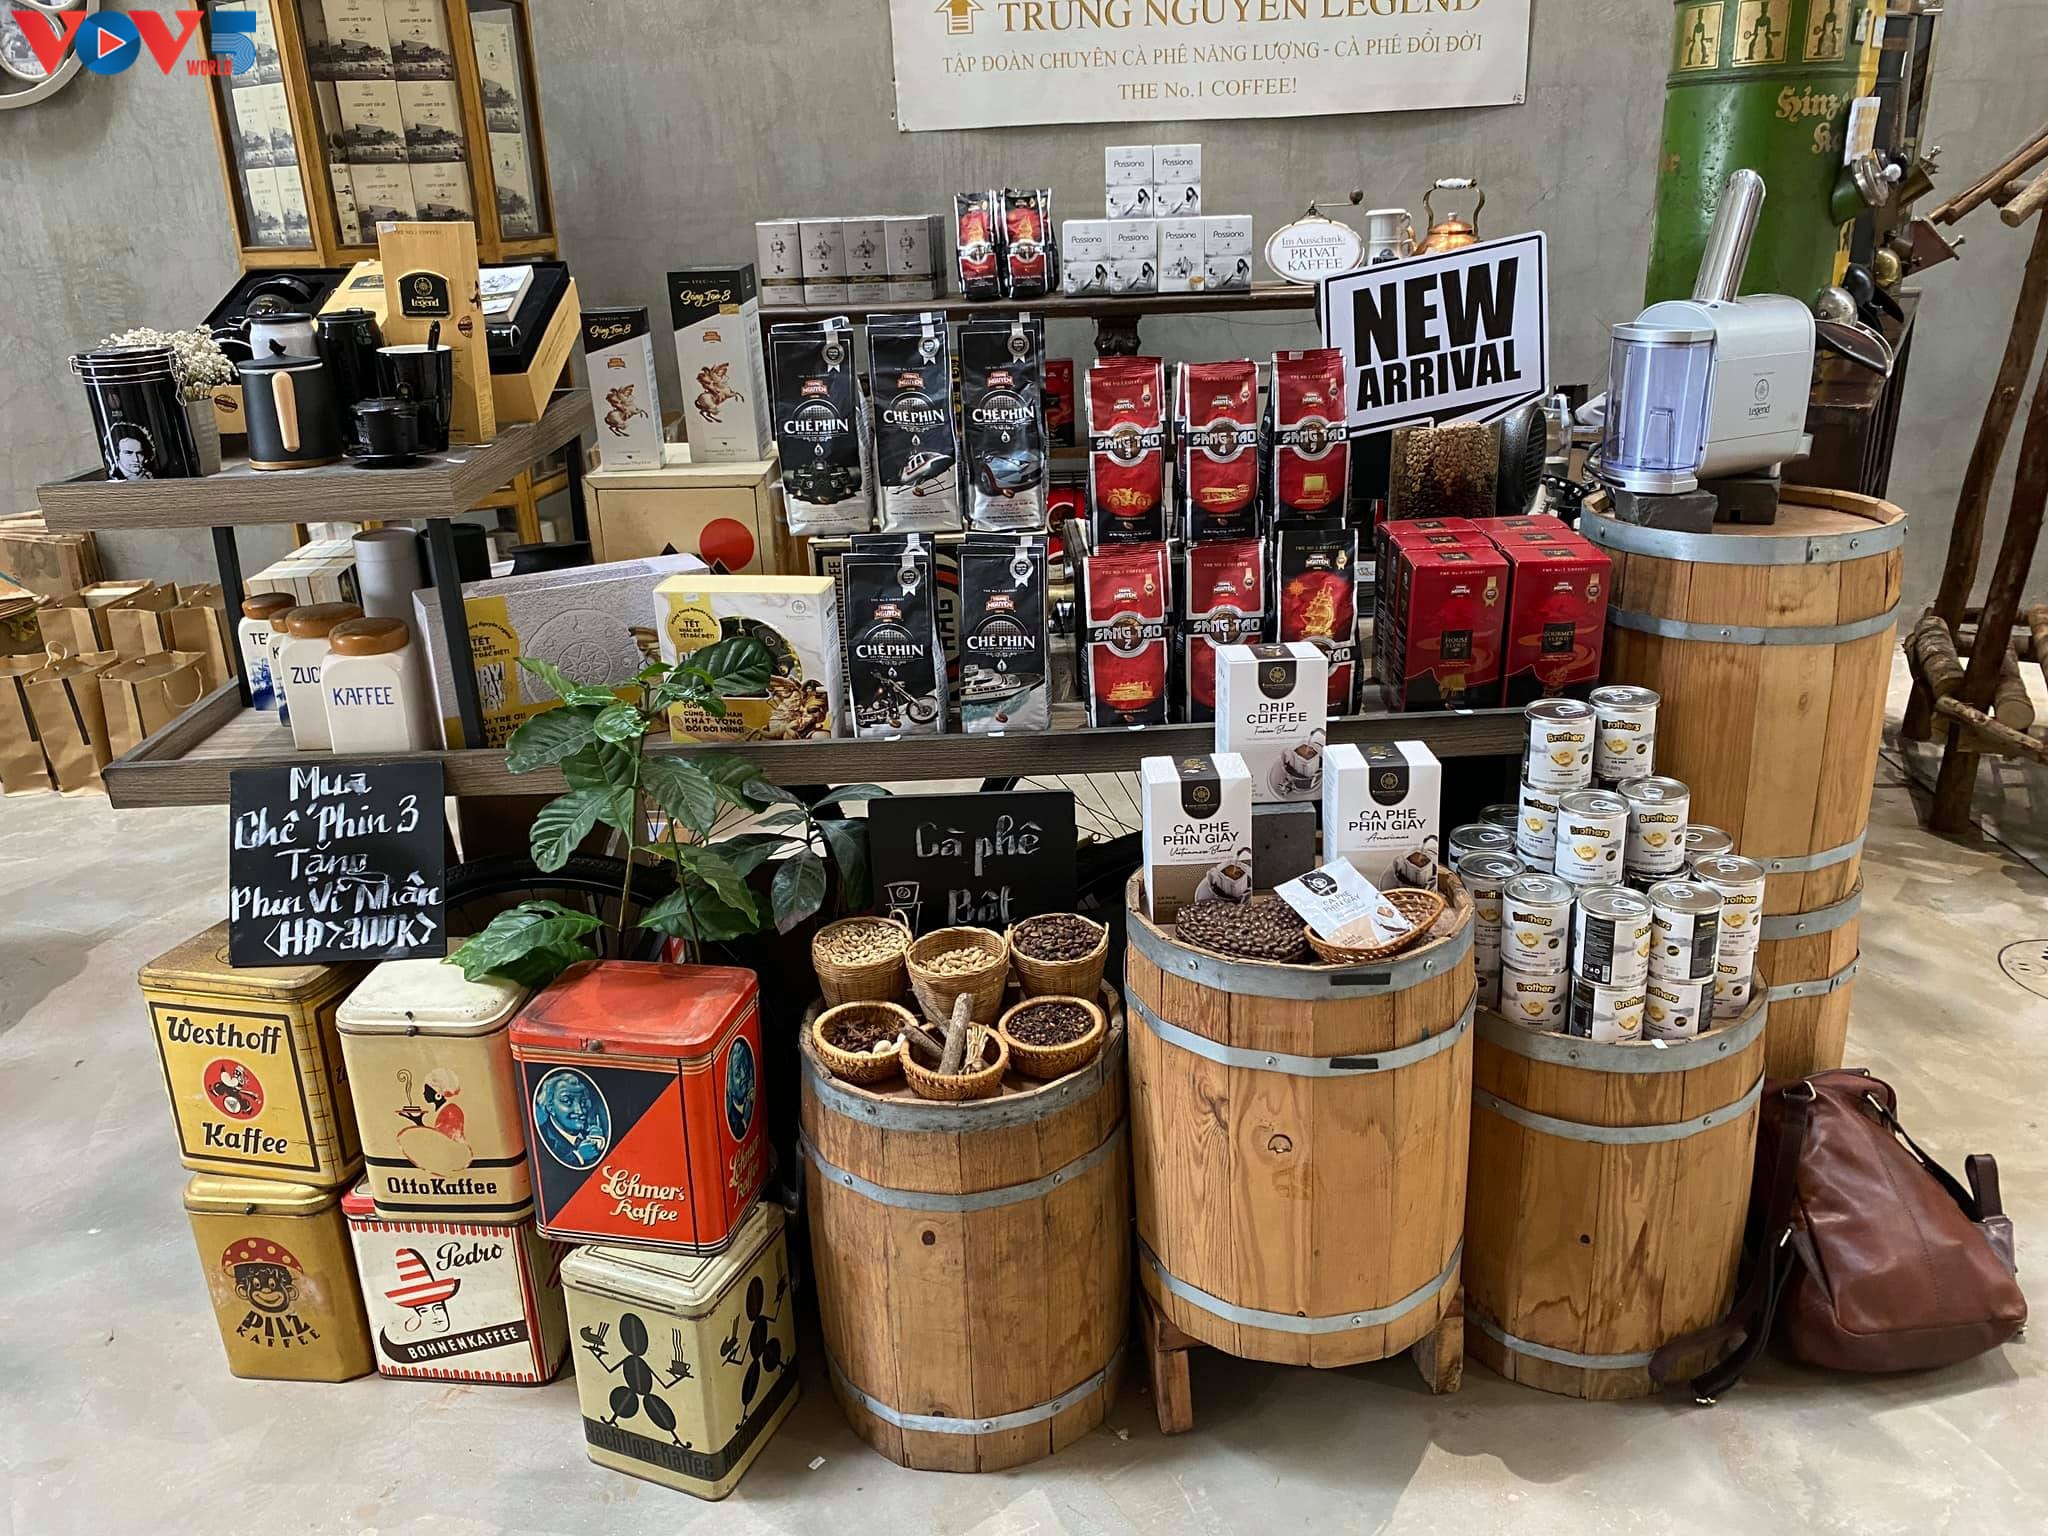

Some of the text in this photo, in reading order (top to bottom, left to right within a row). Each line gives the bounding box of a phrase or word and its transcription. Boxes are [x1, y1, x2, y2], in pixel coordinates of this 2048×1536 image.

[998, 0, 1133, 32] TRUNG
[1321, 0, 1481, 19] LEGEND
[1118, 83, 1158, 100] THE
[1212, 77, 1297, 96] COFFEE!
[1287, 258, 1343, 271] KAFFEE
[1291, 247, 1338, 259] PRIVAT
[1353, 257, 1519, 367] NEW
[1357, 339, 1521, 411] ARRIVAL
[290, 666, 322, 684] ZUC
[333, 686, 395, 706] KAFFEE
[1259, 702, 1295, 712] DRIP
[1246, 712, 1307, 724] COFFEE
[1546, 731, 1586, 743] Brothers
[289, 766, 372, 801] Mua
[313, 803, 392, 843] Phin
[397, 794, 420, 834] 3
[1348, 821, 1387, 832] PHIN
[1639, 812, 1679, 824] Brothers
[974, 815, 1043, 877] phê
[1163, 834, 1200, 846] PHIN
[166, 1016, 282, 1055] Westhoff
[202, 1121, 288, 1155] Kaffee
[610, 1199, 680, 1226] Kaffee
[436, 1241, 504, 1272] Pedro
[240, 1310, 311, 1338] PILZ
[236, 1325, 321, 1349] KAFFEE
[408, 1326, 519, 1360] BOHNENKAFFEE
